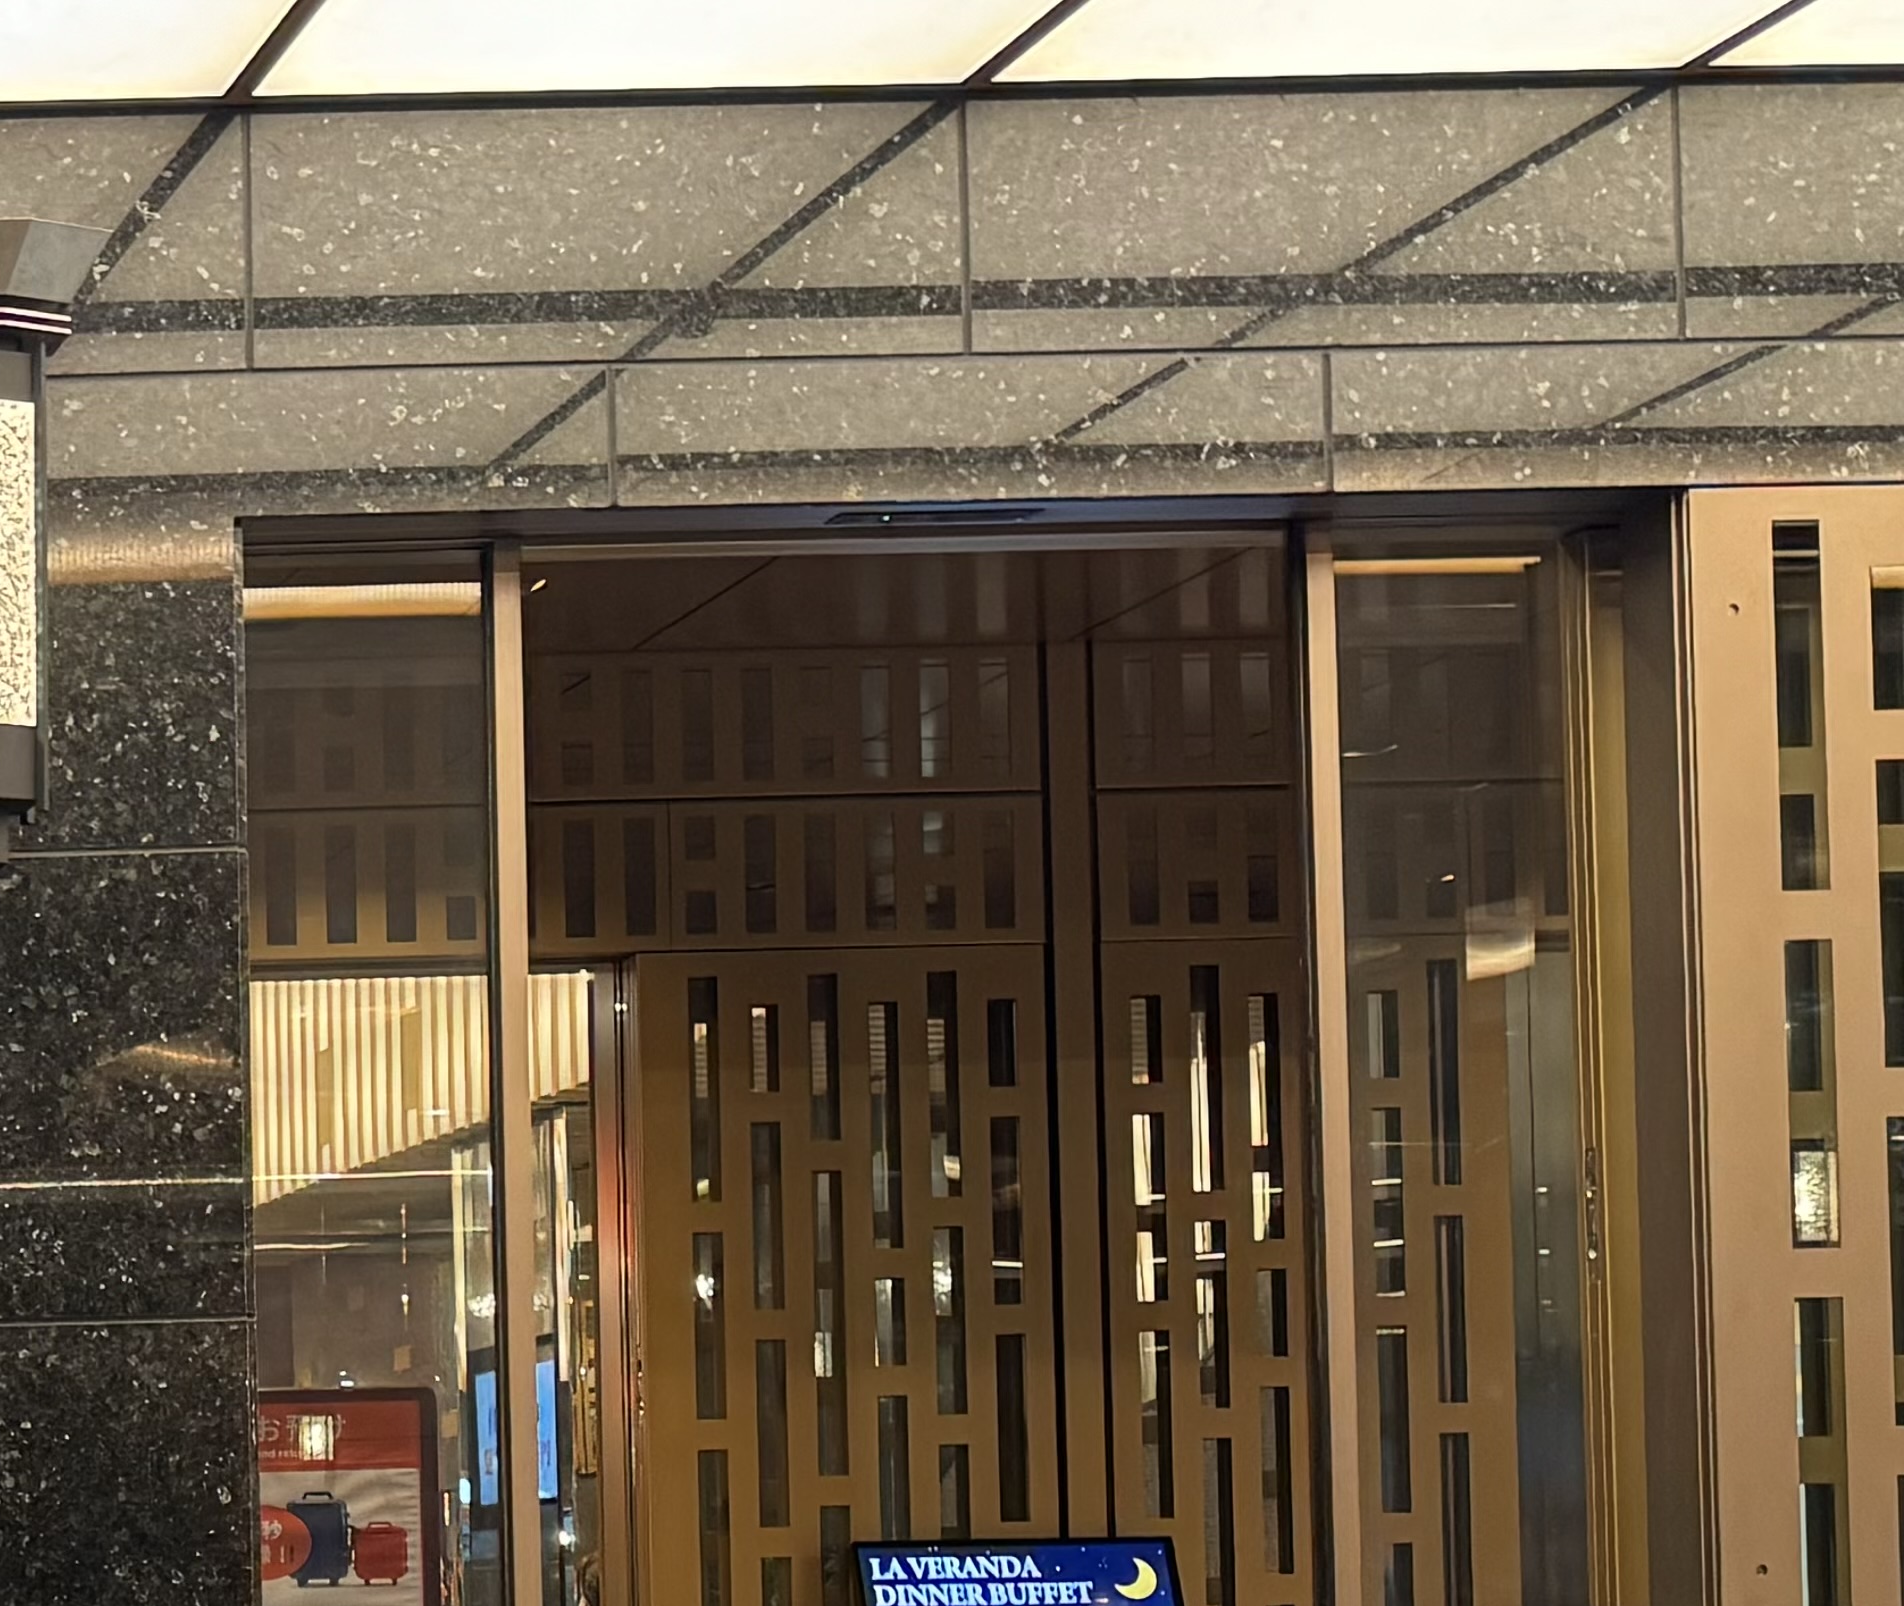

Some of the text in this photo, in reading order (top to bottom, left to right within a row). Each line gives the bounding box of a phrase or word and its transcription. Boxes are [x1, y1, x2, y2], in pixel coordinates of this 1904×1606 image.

[869, 1554, 1042, 1580] LA VERANDA
[987, 1581, 1094, 1606] BUFFET
